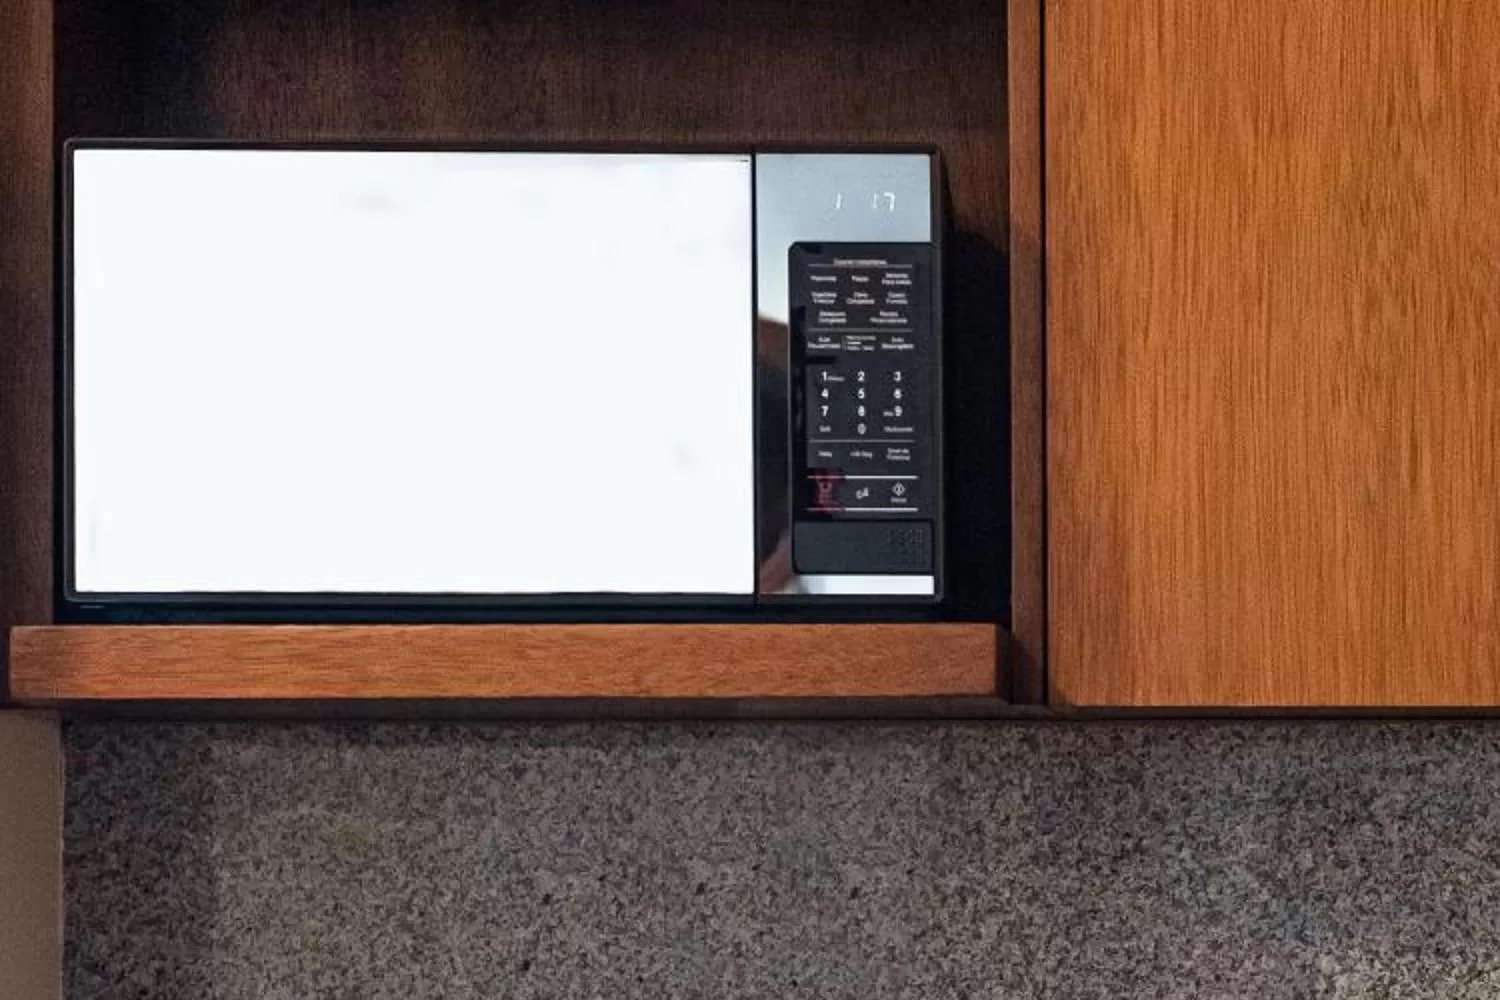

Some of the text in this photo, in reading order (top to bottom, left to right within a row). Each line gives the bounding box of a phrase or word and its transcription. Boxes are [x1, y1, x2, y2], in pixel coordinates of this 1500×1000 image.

[857, 371, 865, 381] 2
[893, 371, 901, 382] 3
[821, 388, 829, 399] 4
[857, 388, 865, 399] 5
[893, 388, 902, 399] 6
[821, 405, 829, 417] 7
[857, 405, 865, 417] 8
[894, 405, 903, 417] 9
[857, 423, 866, 435] 0
